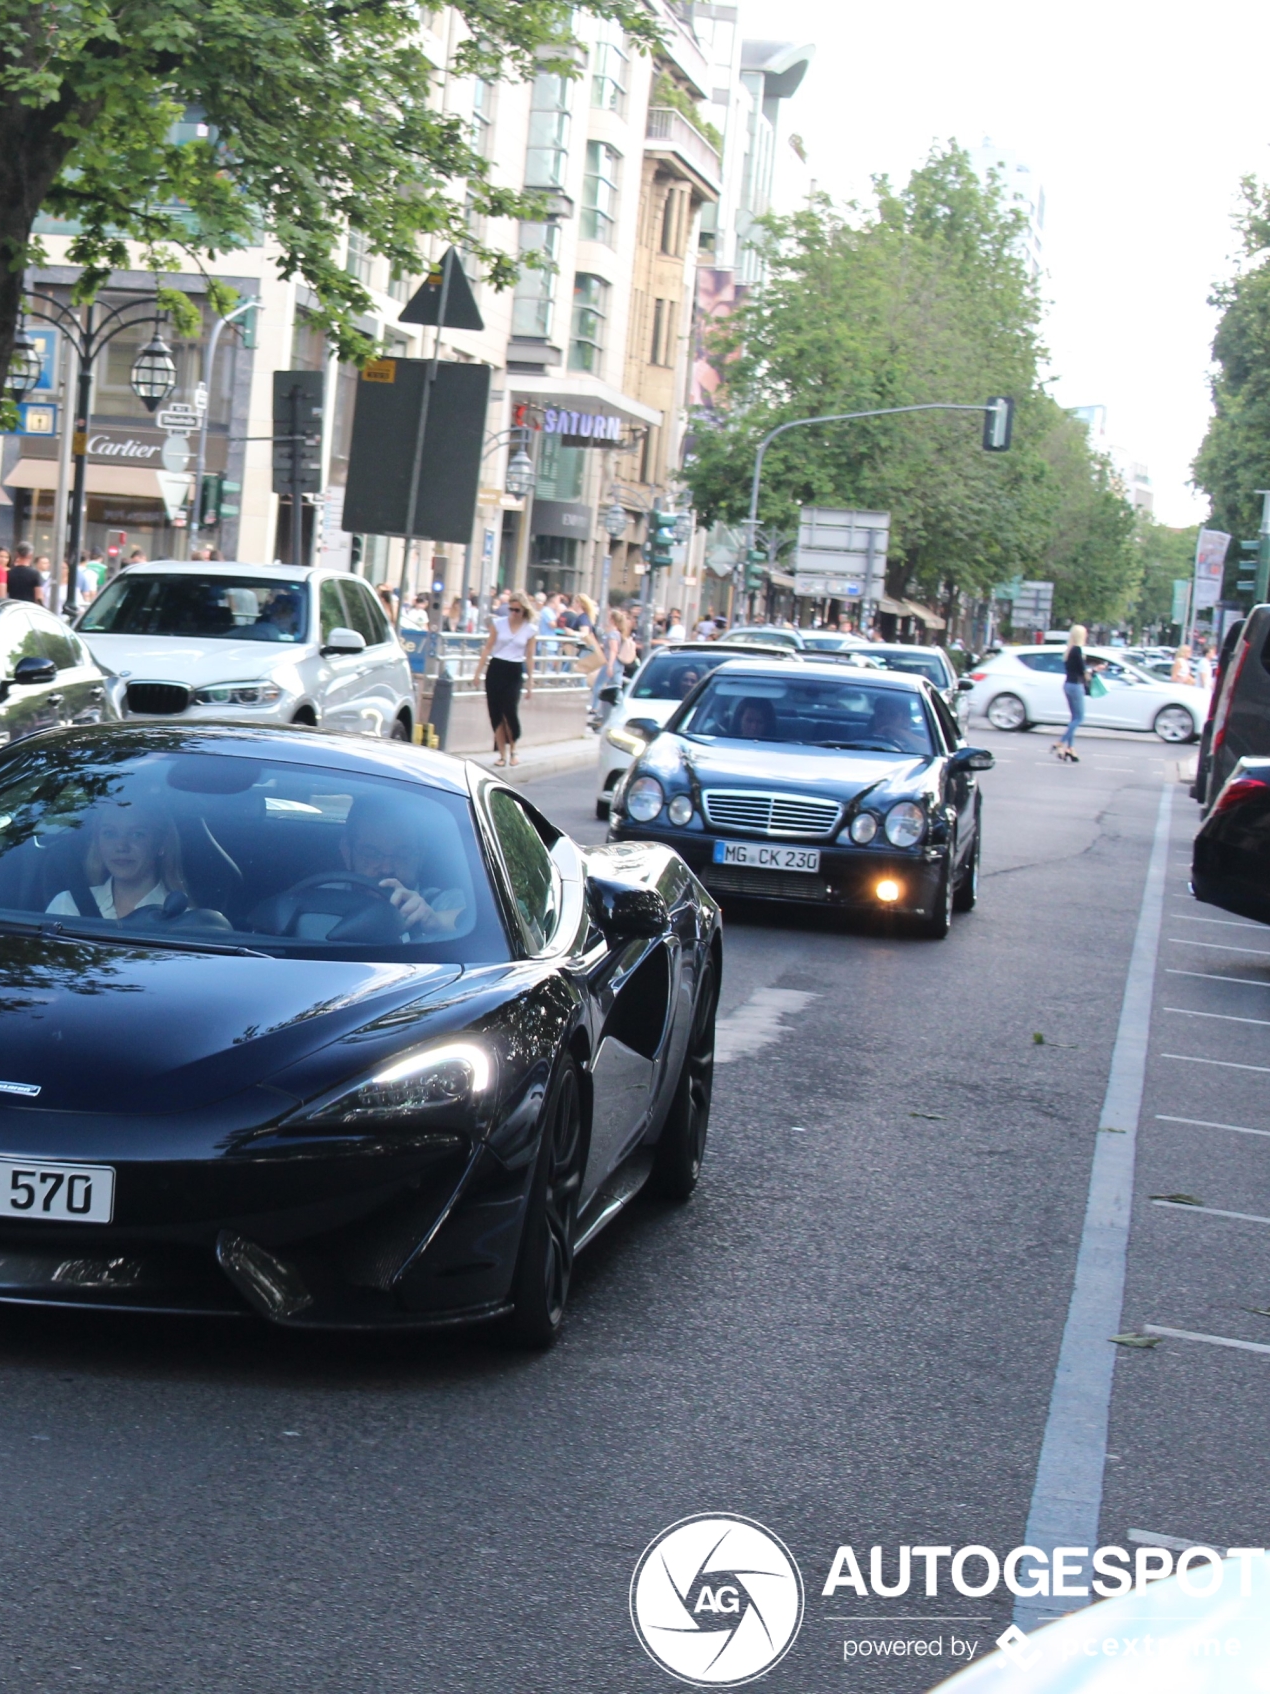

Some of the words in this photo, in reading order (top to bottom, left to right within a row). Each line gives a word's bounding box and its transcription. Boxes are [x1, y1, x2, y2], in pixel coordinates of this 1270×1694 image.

[544, 408, 621, 440] SATURN
[86, 434, 161, 458] Cartier
[725, 846, 747, 863] MG
[759, 849, 780, 866] CK
[785, 851, 817, 869] 230
[10, 1167, 93, 1214] 570
